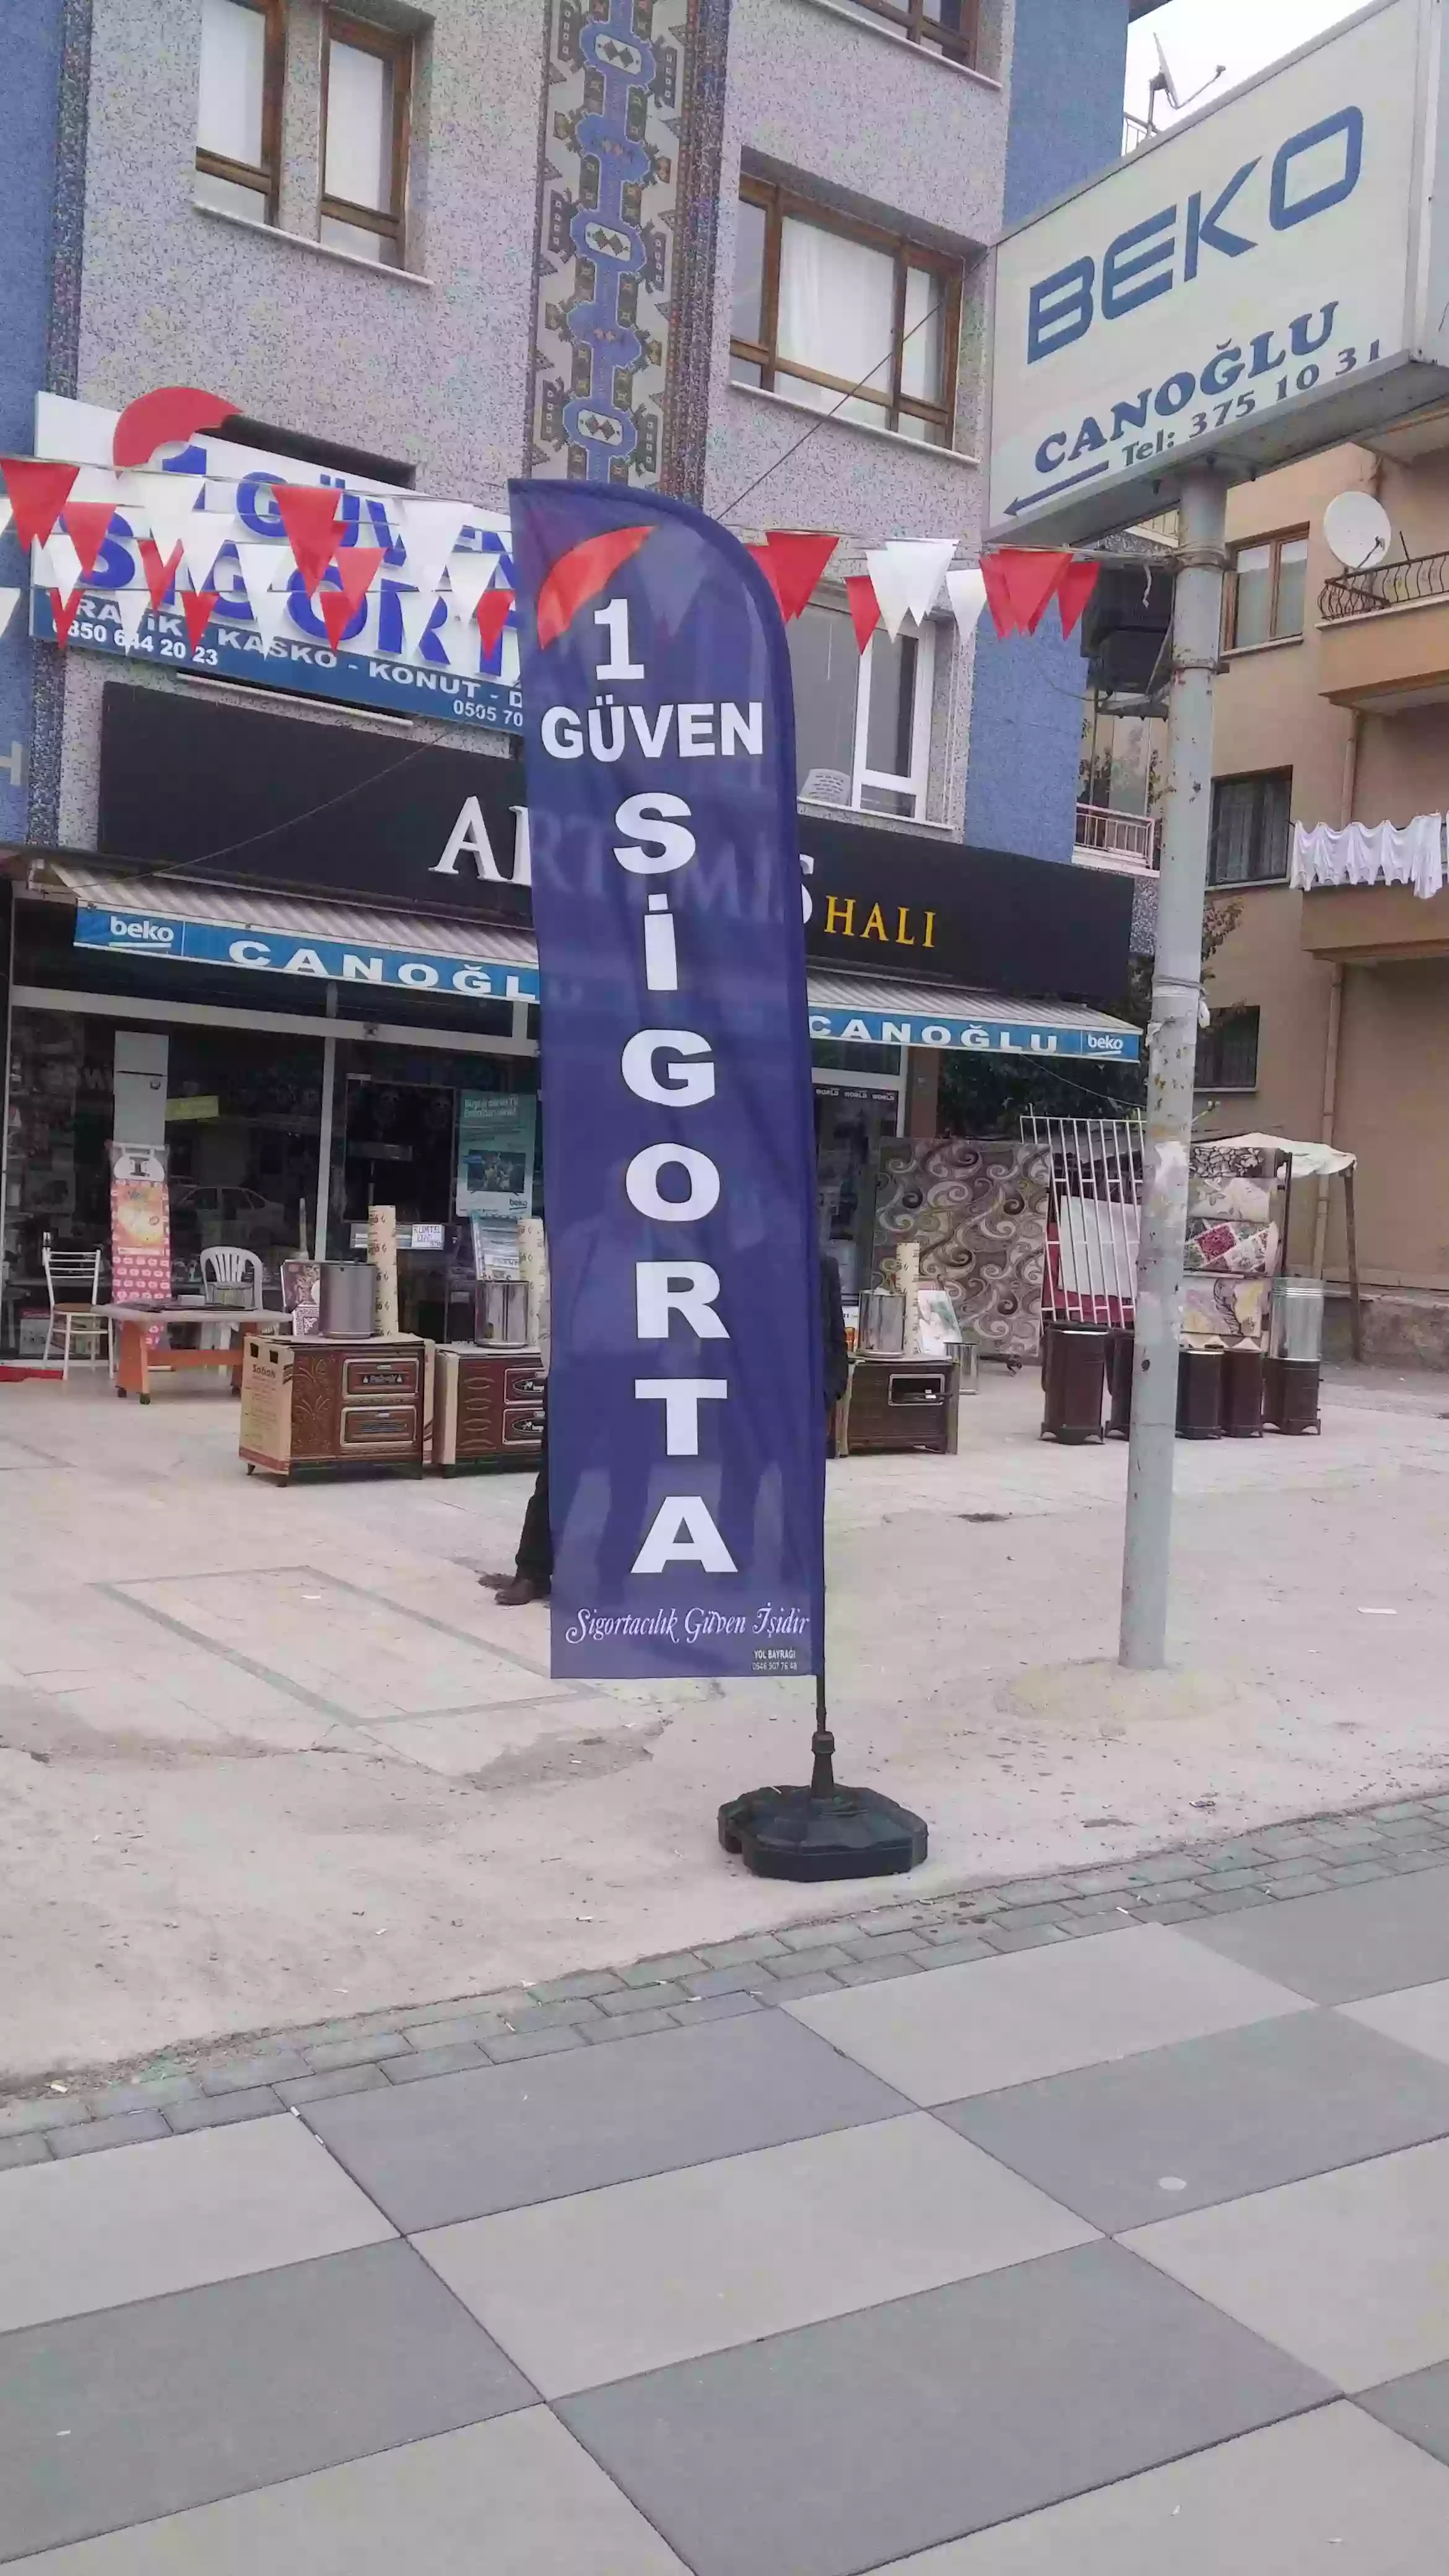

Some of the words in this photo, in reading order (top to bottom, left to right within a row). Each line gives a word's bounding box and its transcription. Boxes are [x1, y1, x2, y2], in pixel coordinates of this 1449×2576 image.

[1027, 106, 1364, 365] BEKO
[1034, 301, 1339, 474] CANOĞLU
[1121, 430, 1175, 467] Tel:
[1188, 390, 1256, 439] 375
[1276, 363, 1320, 401] 10
[1334, 339, 1380, 376] 31
[52, 620, 107, 643] 850
[160, 638, 186, 659] 20
[192, 646, 218, 666] 23
[217, 629, 337, 668] KASKO
[369, 661, 481, 699] KONUT
[594, 598, 644, 681] 1
[453, 699, 497, 721] 0505
[541, 694, 763, 762] GÜVEN
[824, 895, 936, 949] HALI
[110, 915, 175, 944] beko
[228, 940, 537, 1001] CANOĞL
[809, 1015, 1058, 1053] CANOĞLU
[1087, 1033, 1123, 1051] beko
[565, 1608, 680, 1643] Sigortacılık
[684, 1608, 746, 1643] Güven
[752, 1602, 810, 1638] İşidir
[754, 1650, 767, 1660] YOL
[768, 1647, 796, 1660] BAYRAĞI
